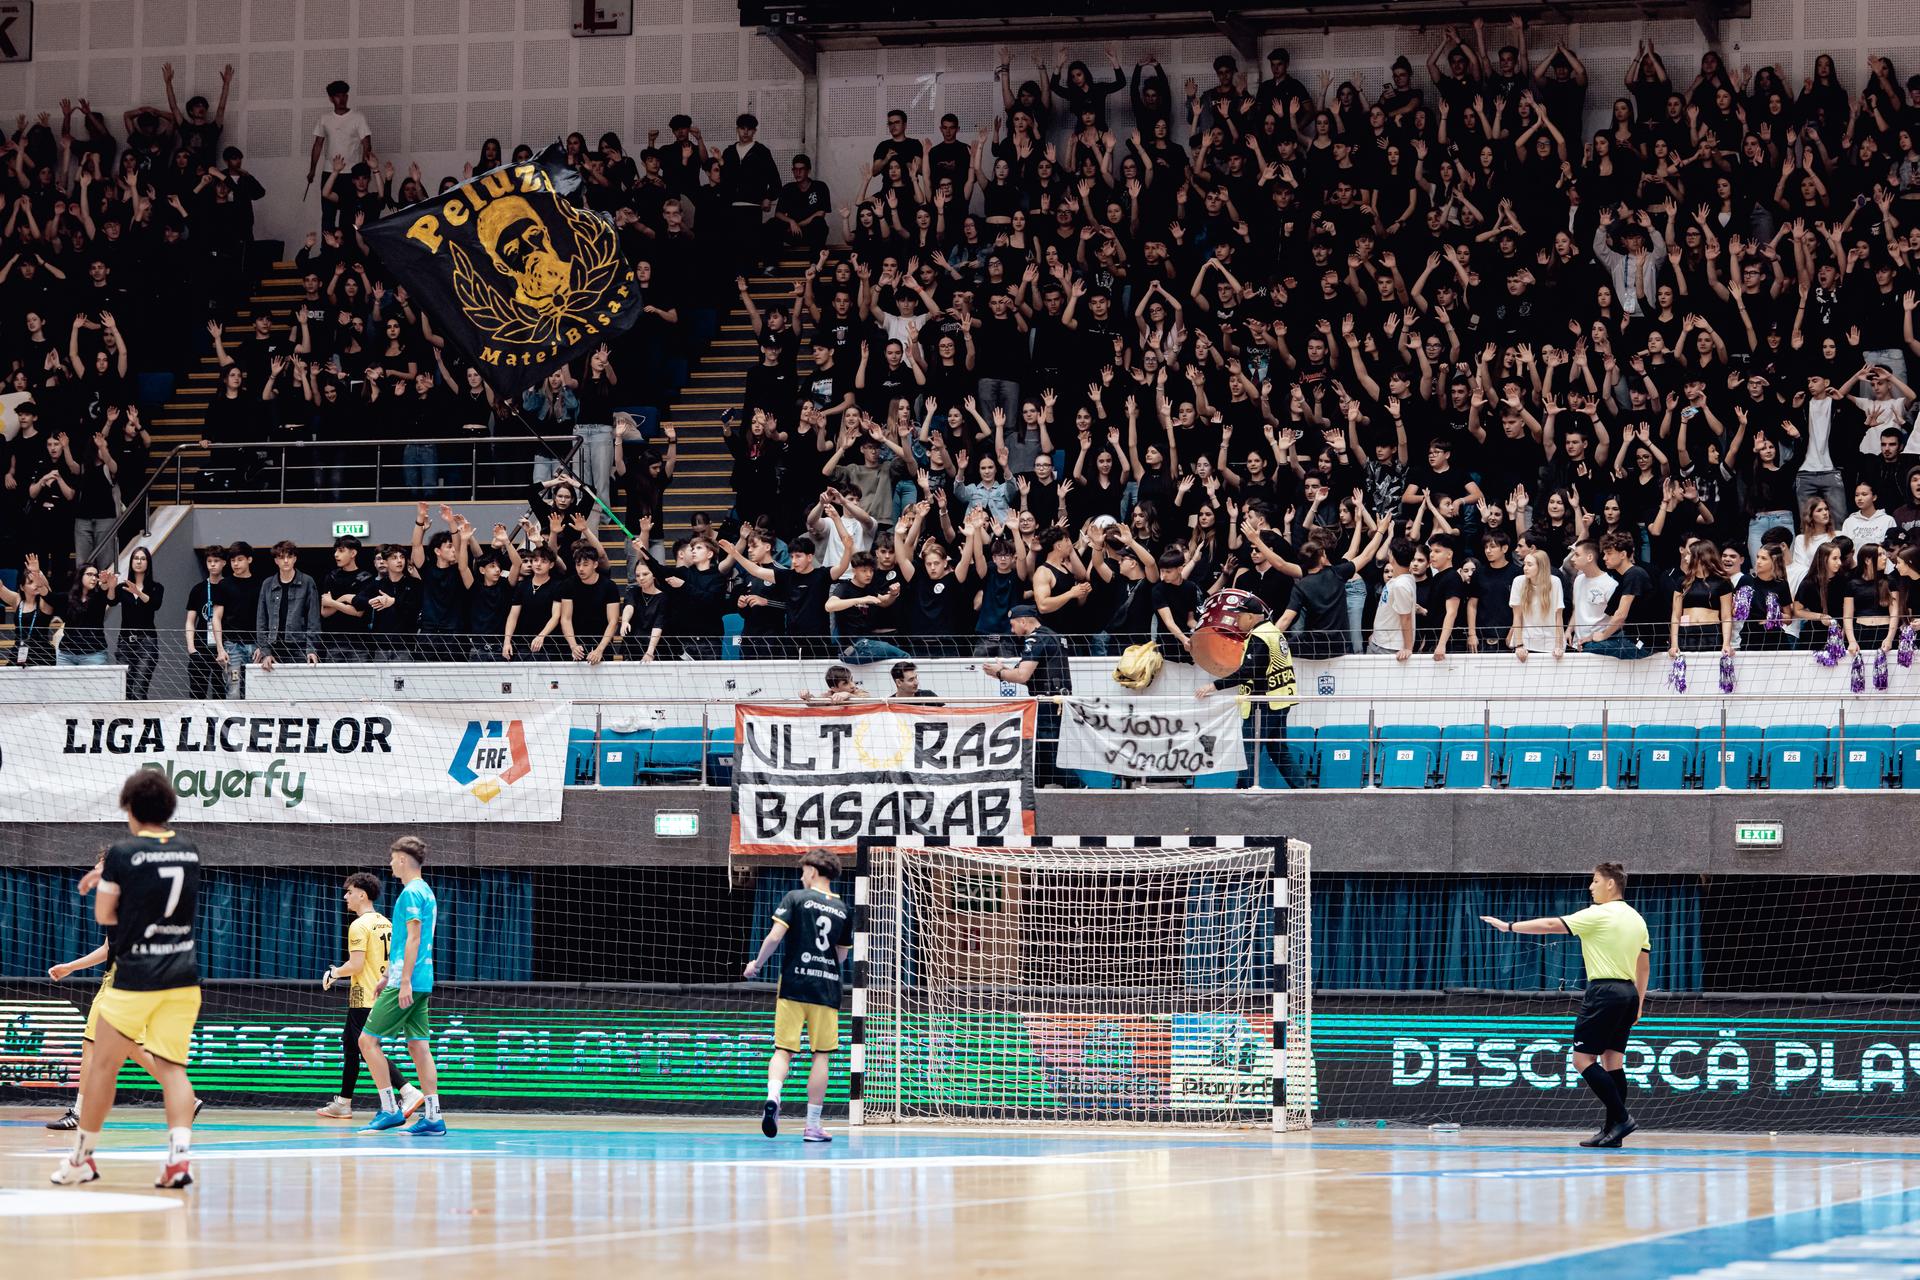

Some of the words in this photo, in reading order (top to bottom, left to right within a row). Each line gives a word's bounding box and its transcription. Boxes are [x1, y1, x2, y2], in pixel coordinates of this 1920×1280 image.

[480, 341, 557, 366] Matei
[338, 525, 362, 533] EXIT
[63, 718, 165, 754] LIGA
[176, 716, 393, 754] LICEELOR
[914, 717, 1022, 769] RAS
[476, 747, 508, 769] FRF
[1400, 752, 1410, 760] 20
[1465, 752, 1474, 760] 21
[1787, 753, 1797, 761] 26
[755, 789, 1011, 839] BASARAB
[1744, 830, 1772, 839] EXIT
[158, 866, 185, 918] 7
[815, 915, 832, 952] 3
[1774, 1040, 1920, 1094] PLA
